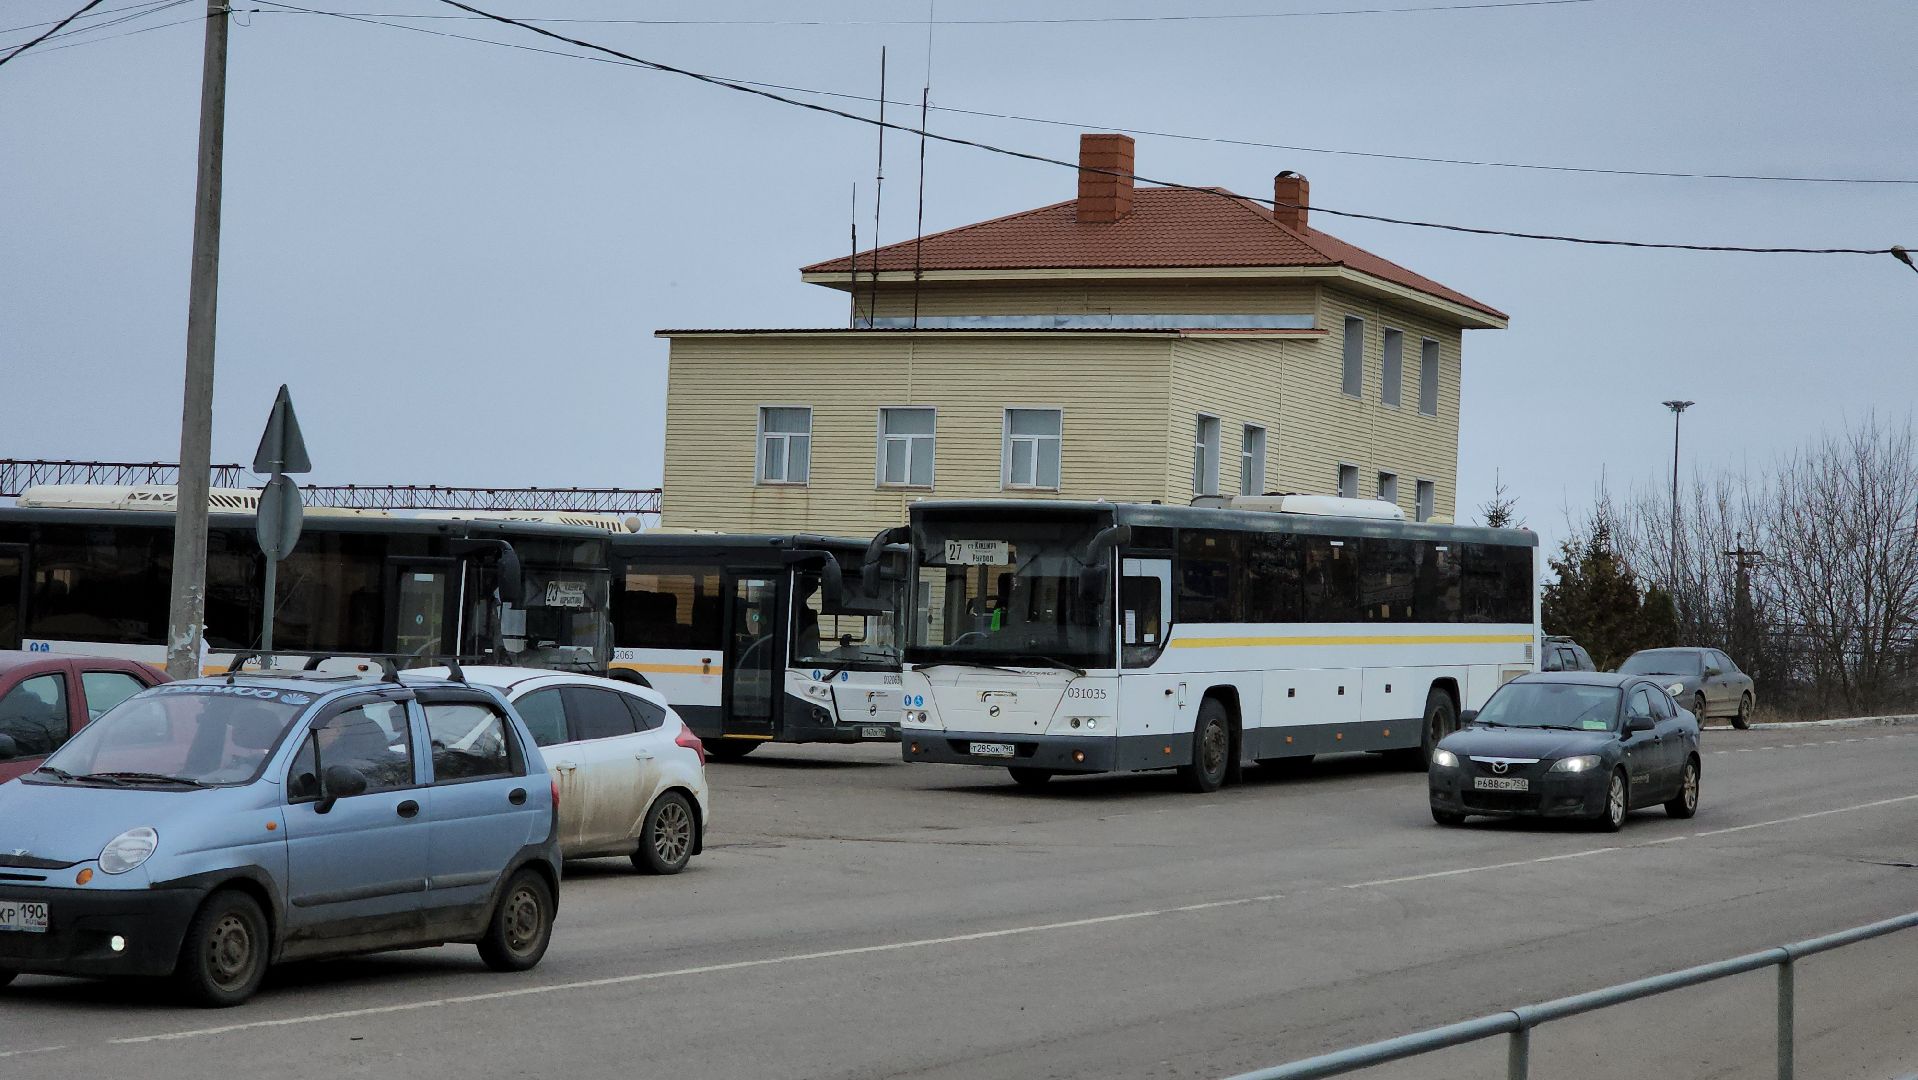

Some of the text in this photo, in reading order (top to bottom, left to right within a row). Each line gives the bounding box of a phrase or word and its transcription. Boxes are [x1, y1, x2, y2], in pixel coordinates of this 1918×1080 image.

[949, 543, 962, 561] 27
[547, 582, 559, 602] 23
[1067, 687, 1108, 700] 031035
[20, 904, 44, 919] 190
